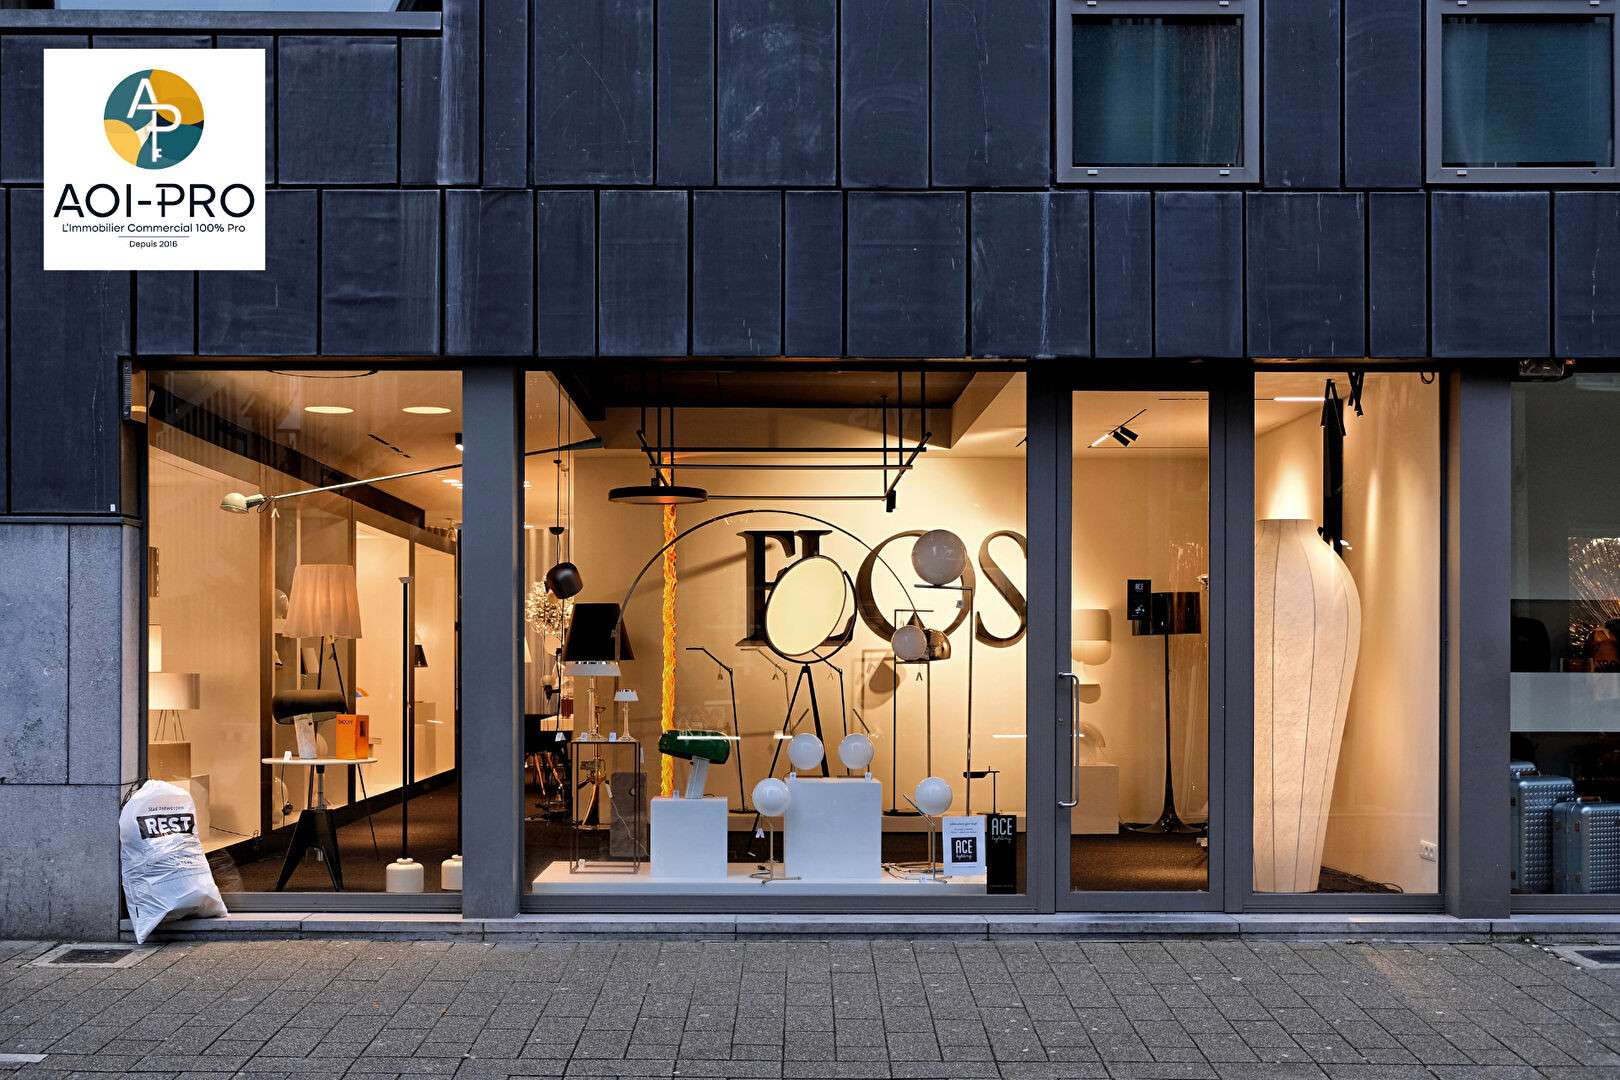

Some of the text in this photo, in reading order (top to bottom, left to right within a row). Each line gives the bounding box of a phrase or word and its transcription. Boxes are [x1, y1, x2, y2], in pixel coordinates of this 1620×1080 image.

[144, 817, 191, 834] REST
[991, 817, 1013, 835] ACE
[956, 839, 973, 854] ACE
